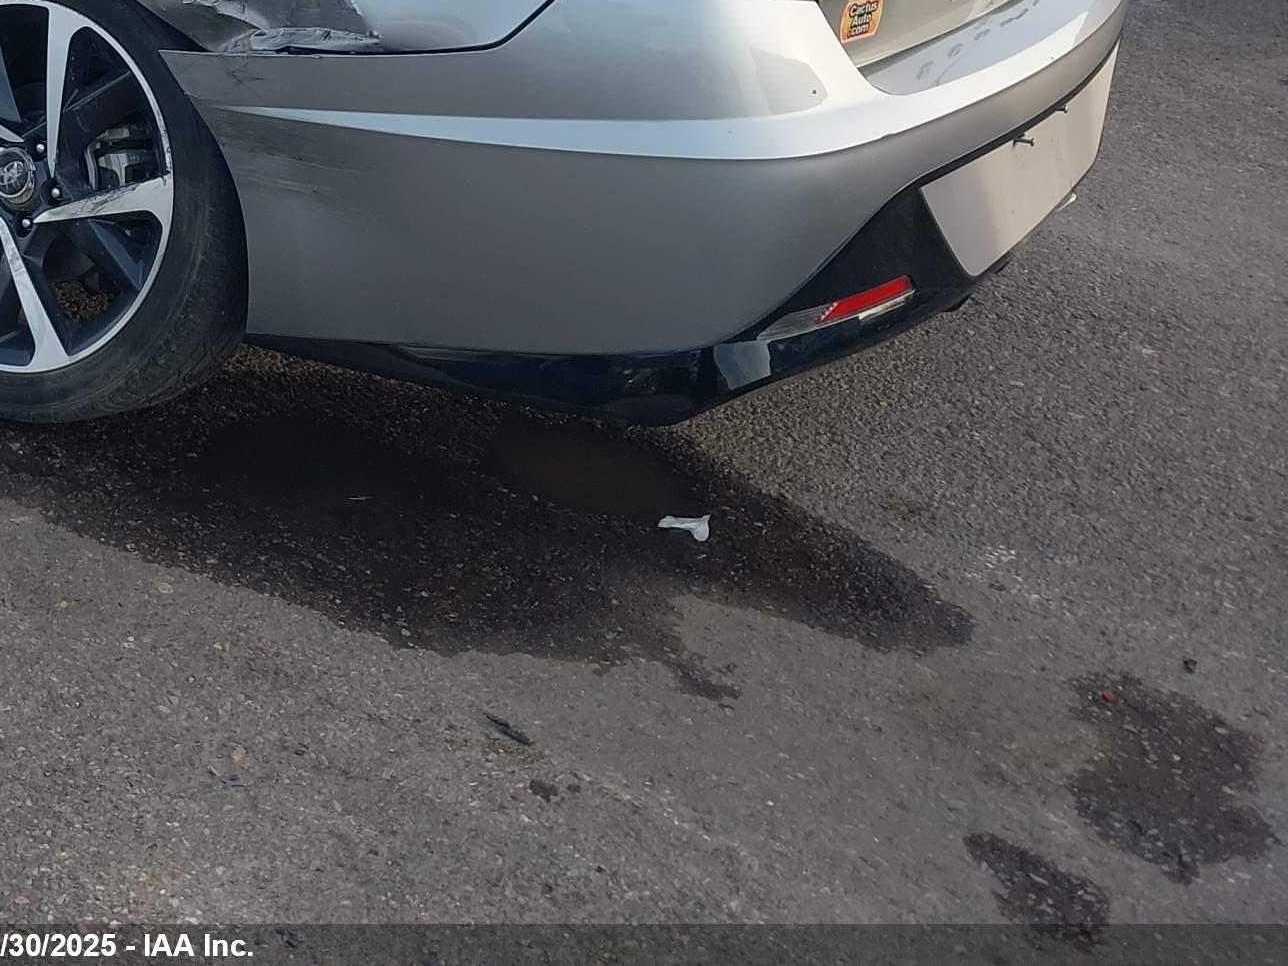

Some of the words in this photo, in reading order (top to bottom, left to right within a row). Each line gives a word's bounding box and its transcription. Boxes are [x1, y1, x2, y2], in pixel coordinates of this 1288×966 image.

[849, 0, 879, 17] Cactus
[852, 13, 872, 27] Auto
[848, 23, 869, 38] .com
